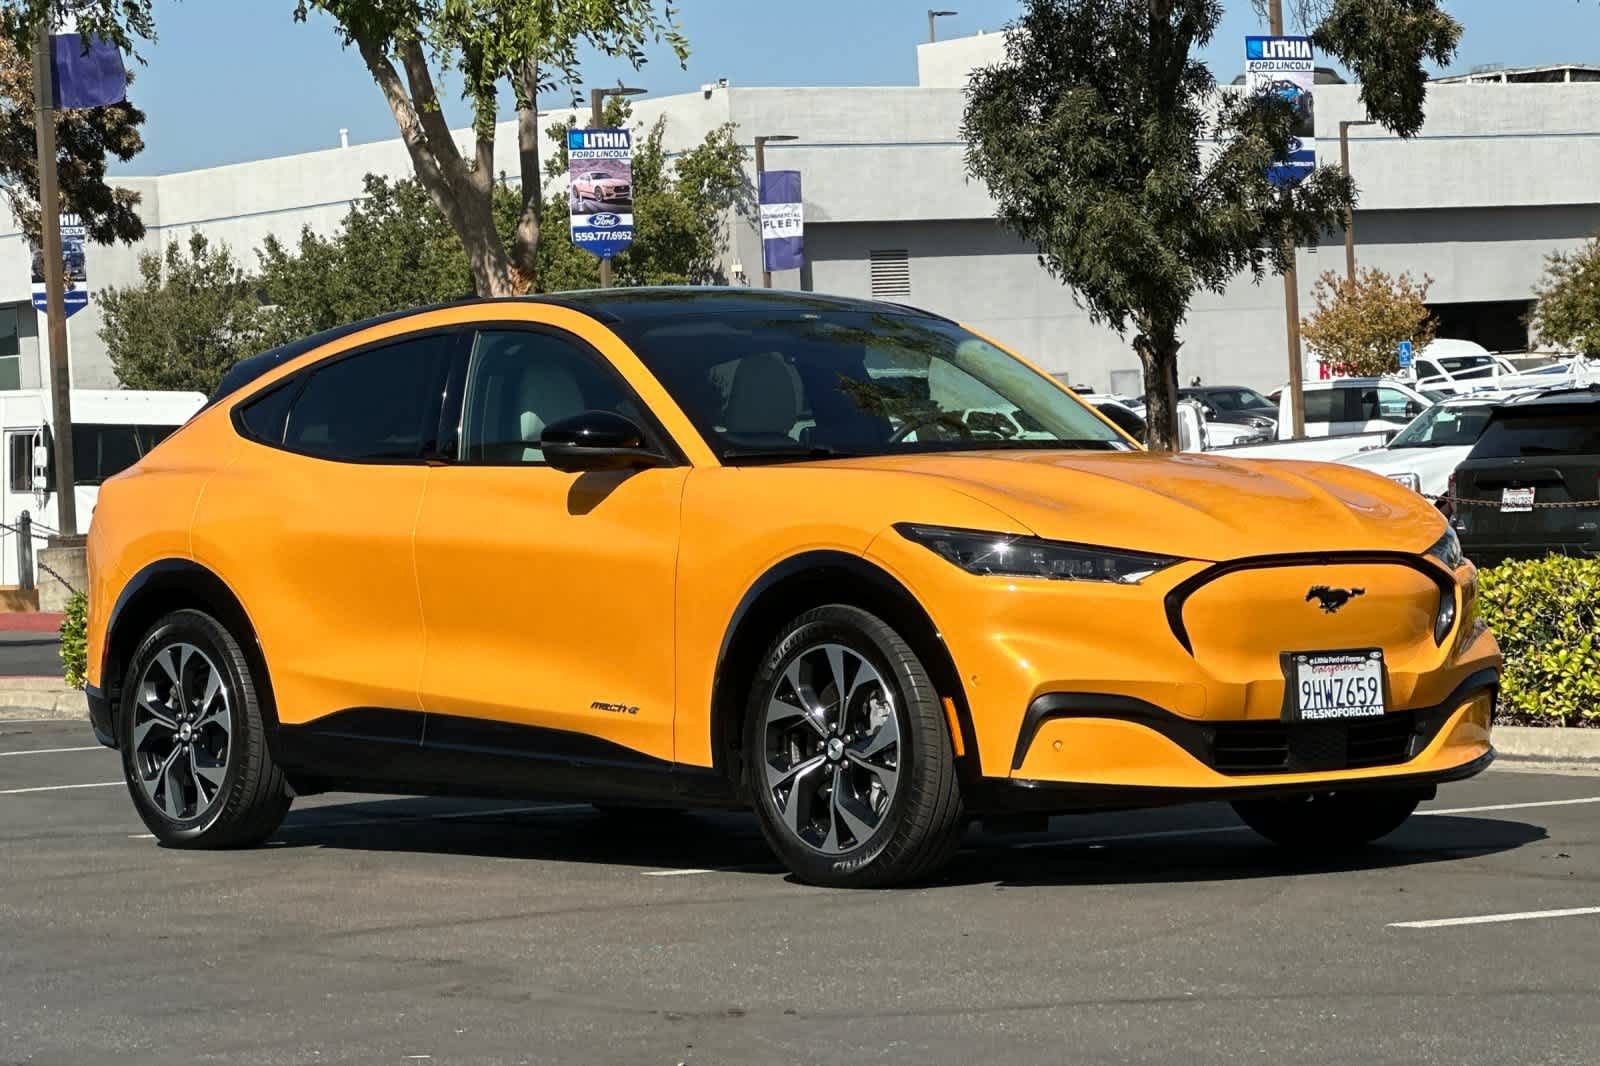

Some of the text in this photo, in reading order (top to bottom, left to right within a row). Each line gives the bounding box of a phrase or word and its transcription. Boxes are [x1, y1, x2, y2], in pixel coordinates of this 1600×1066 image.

[1262, 40, 1313, 59] LITHIA
[1250, 61, 1312, 70] FORD LINCOLN
[584, 132, 628, 148] LITHIA
[572, 150, 628, 158] FORD LINCOLN
[763, 218, 801, 230] FLEET
[575, 230, 632, 242] 559.777.6952
[1302, 676, 1378, 709] 9HWZ659
[1301, 705, 1384, 720] FRESNOFORD.COM
